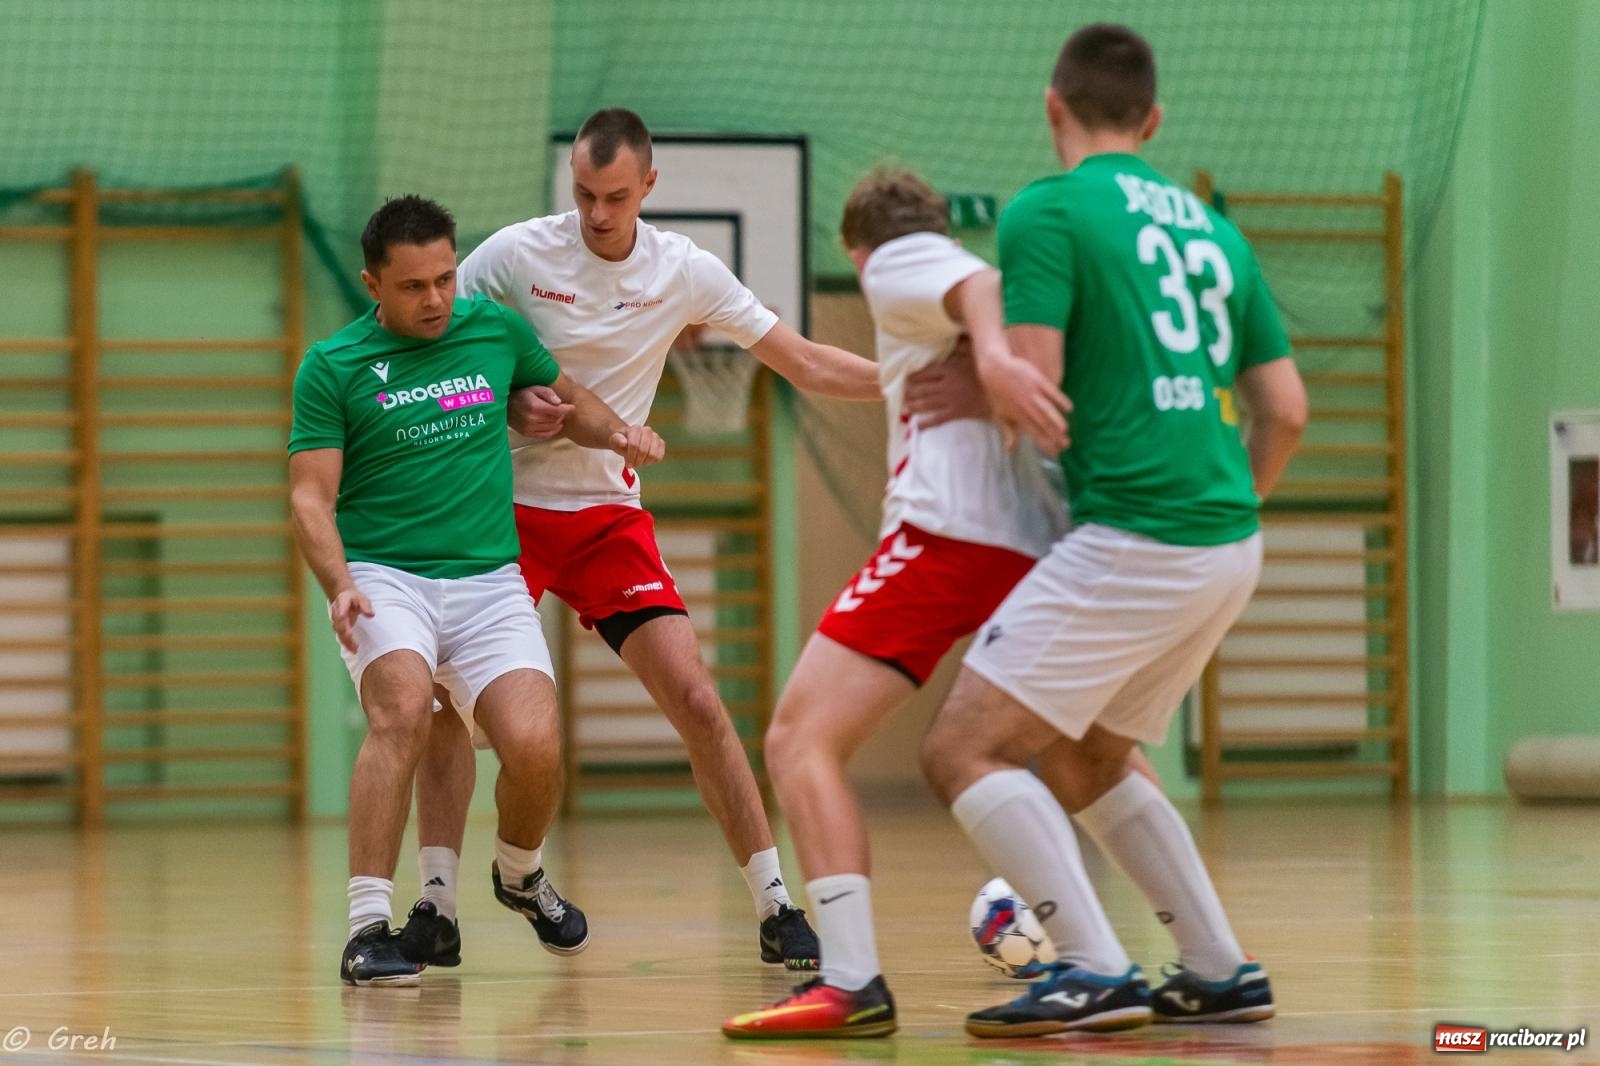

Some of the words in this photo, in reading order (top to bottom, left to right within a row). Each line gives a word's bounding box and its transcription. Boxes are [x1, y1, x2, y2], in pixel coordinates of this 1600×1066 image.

[530, 284, 576, 304] hummel
[1136, 223, 1234, 367] 33
[382, 373, 491, 410] DROGERIA
[443, 398, 456, 408] W
[460, 391, 491, 405] SIECI
[454, 431, 470, 439] SPA
[622, 580, 664, 599] hummel
